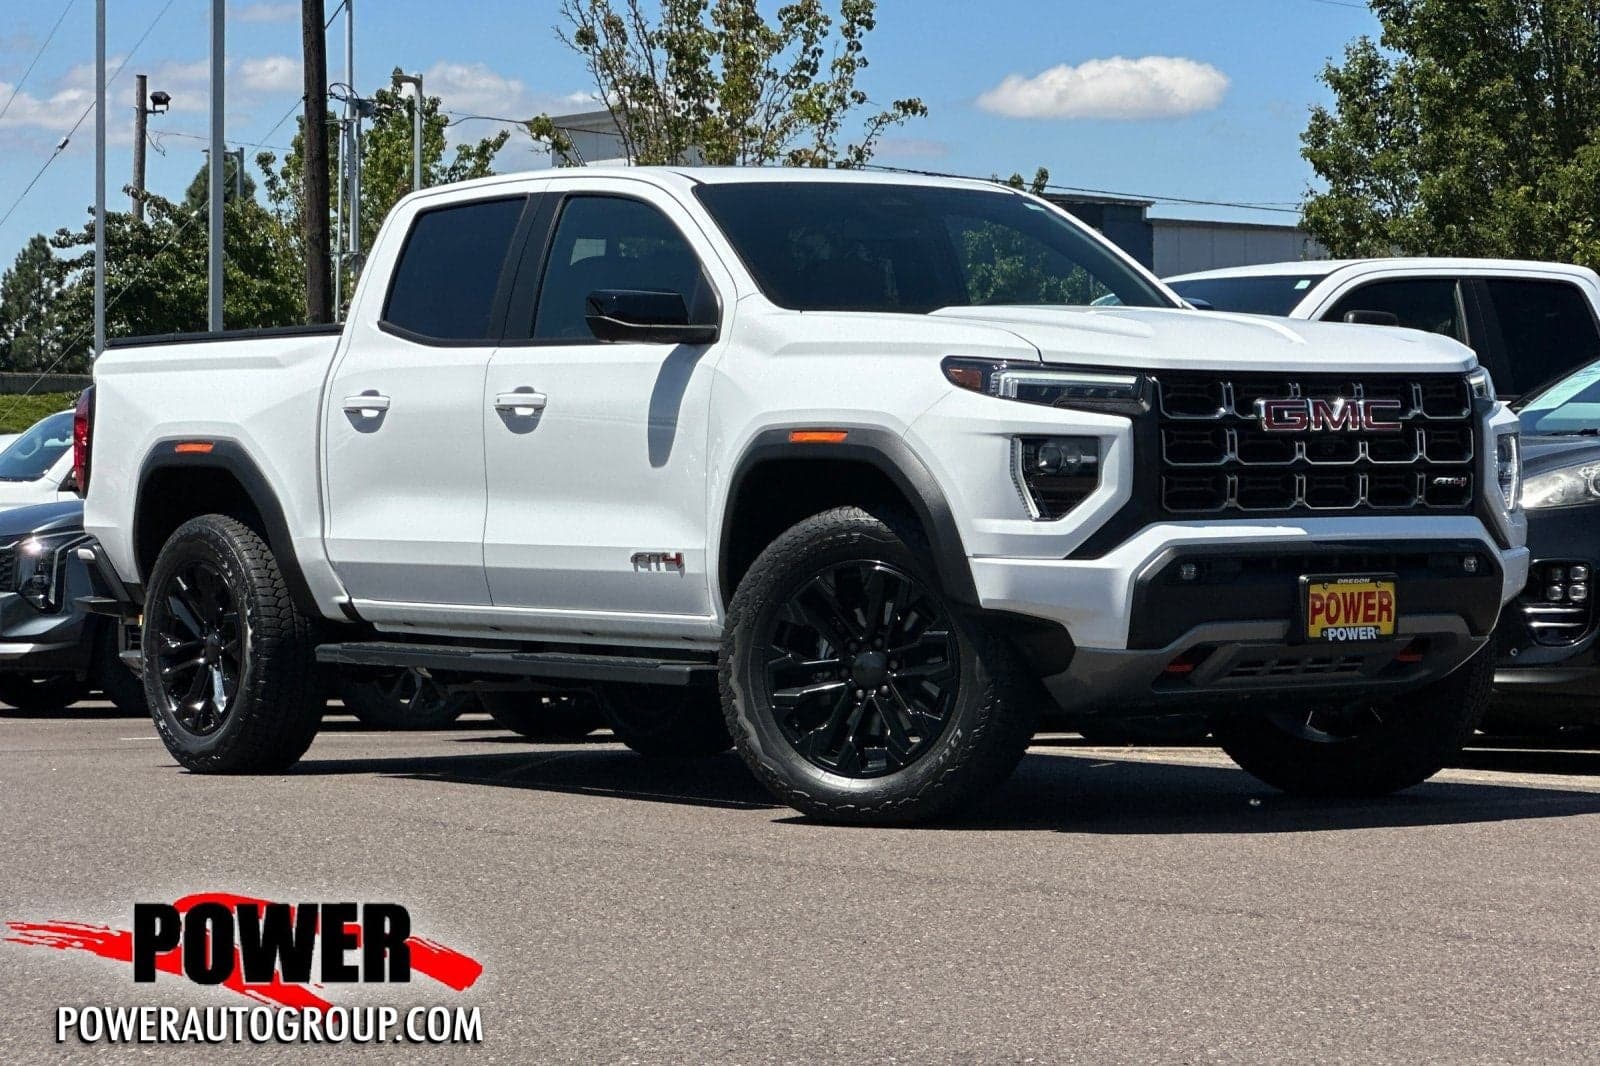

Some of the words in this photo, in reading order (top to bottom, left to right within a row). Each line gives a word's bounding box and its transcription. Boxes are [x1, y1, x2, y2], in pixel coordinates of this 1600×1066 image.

[1256, 398, 1403, 432] GMC
[630, 551, 684, 572] AT4
[1309, 590, 1393, 626] POWER
[1327, 626, 1377, 641] POWER
